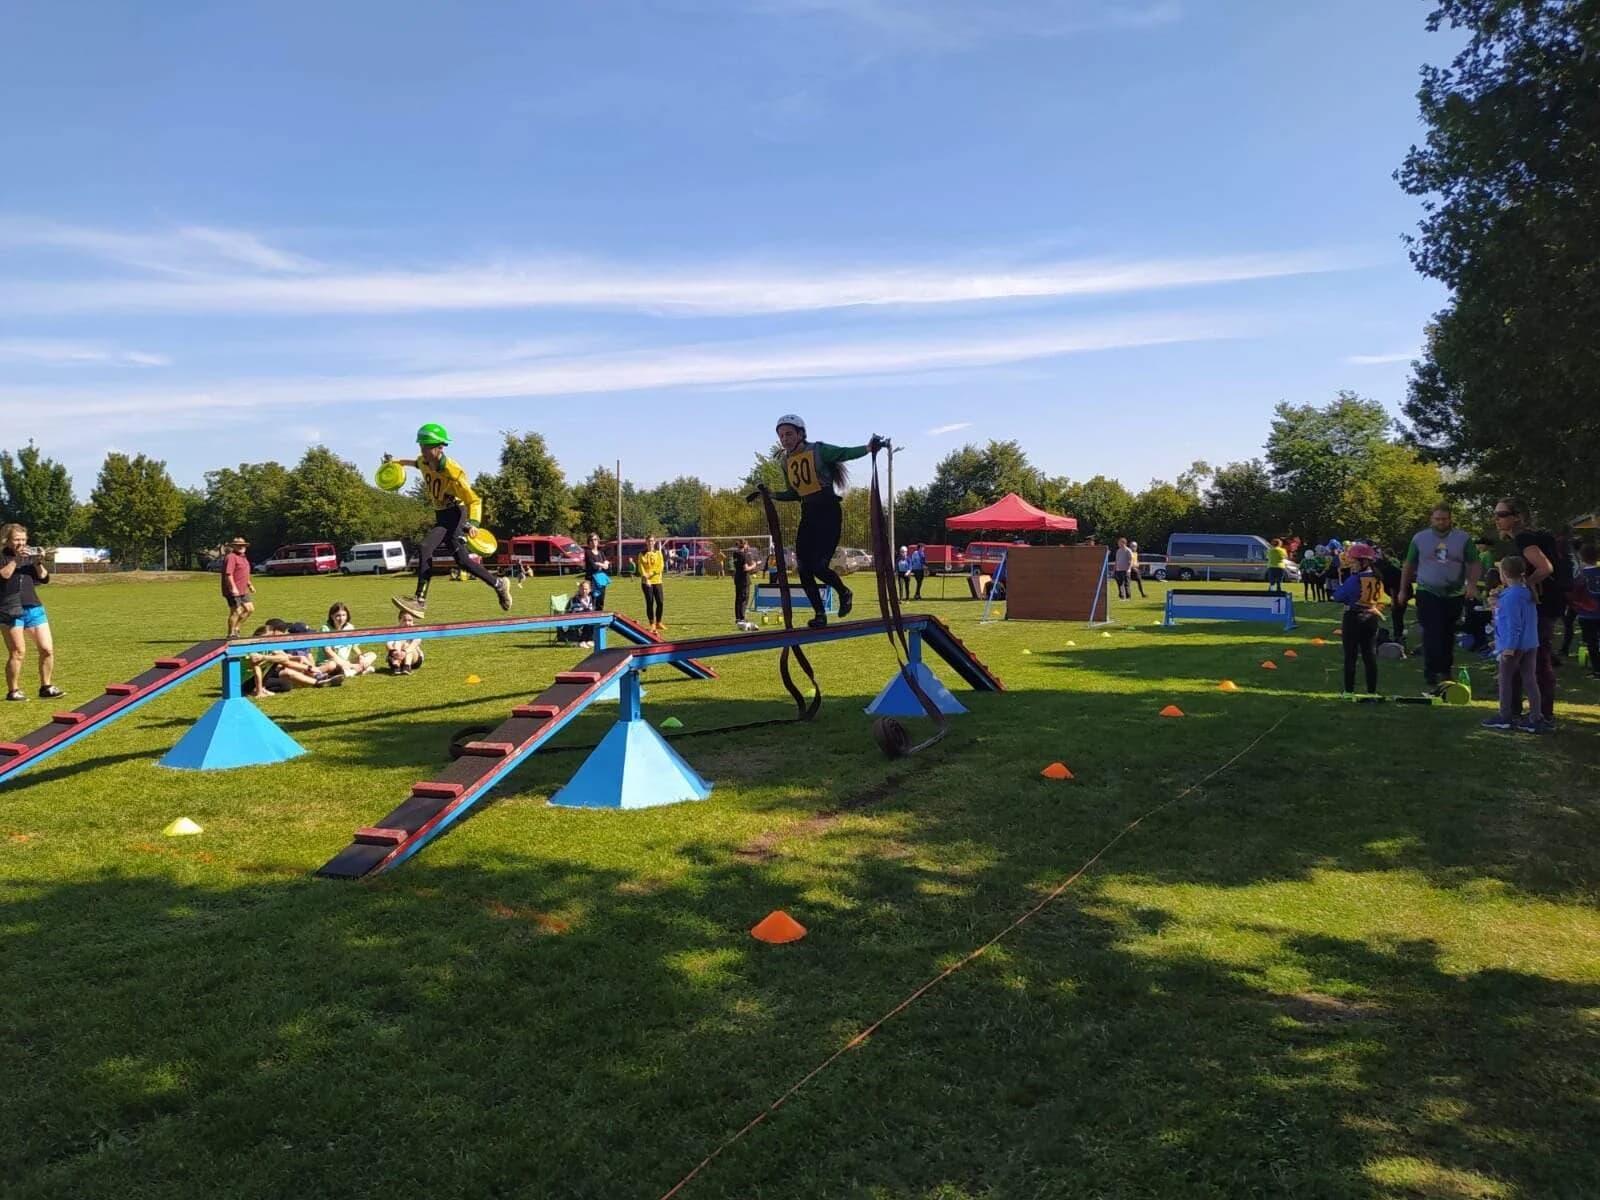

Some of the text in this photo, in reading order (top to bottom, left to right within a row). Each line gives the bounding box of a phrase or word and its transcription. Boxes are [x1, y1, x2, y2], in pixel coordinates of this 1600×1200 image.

[790, 458, 811, 488] 30
[1366, 581, 1381, 602] 18
[1276, 598, 1281, 613] 1
